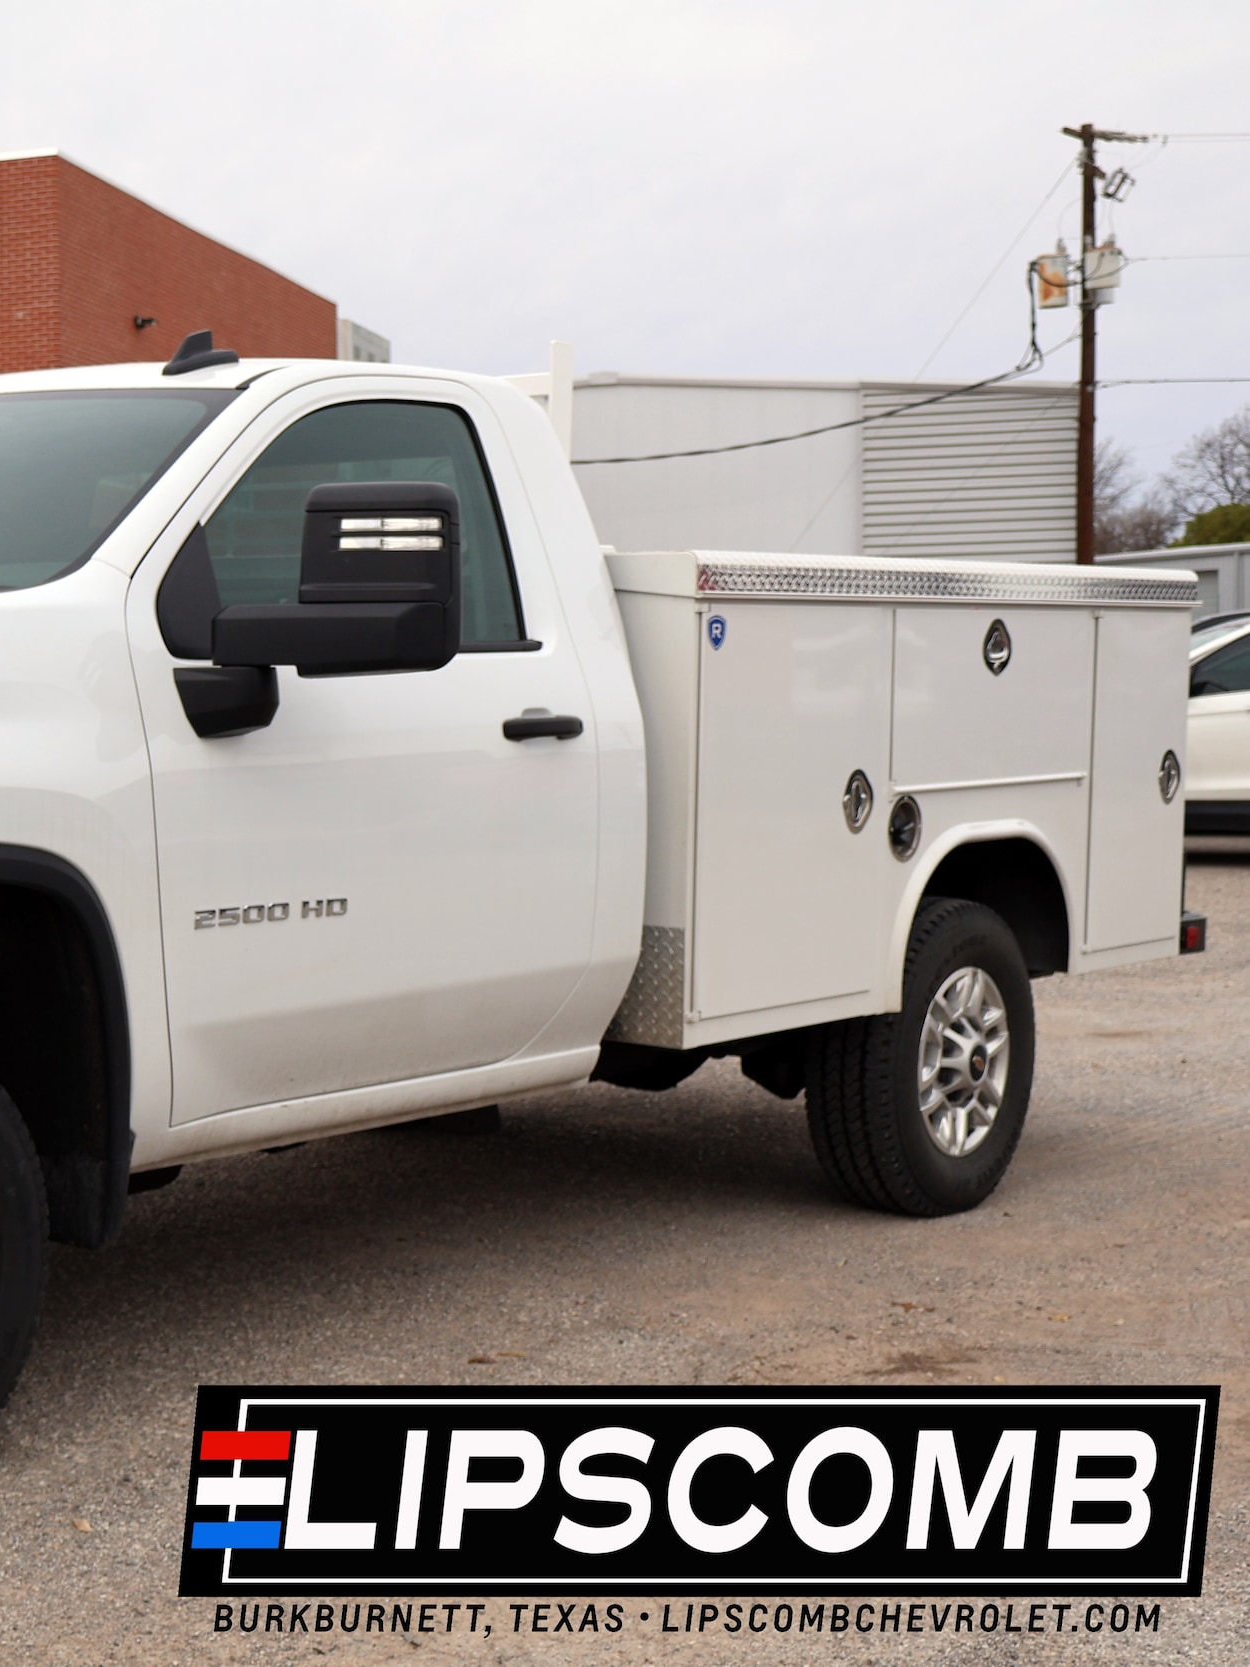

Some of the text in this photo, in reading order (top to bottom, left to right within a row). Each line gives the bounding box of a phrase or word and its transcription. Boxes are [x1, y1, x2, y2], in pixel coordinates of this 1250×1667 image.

[711, 623, 722, 639] R
[193, 898, 348, 930] 2500 HD
